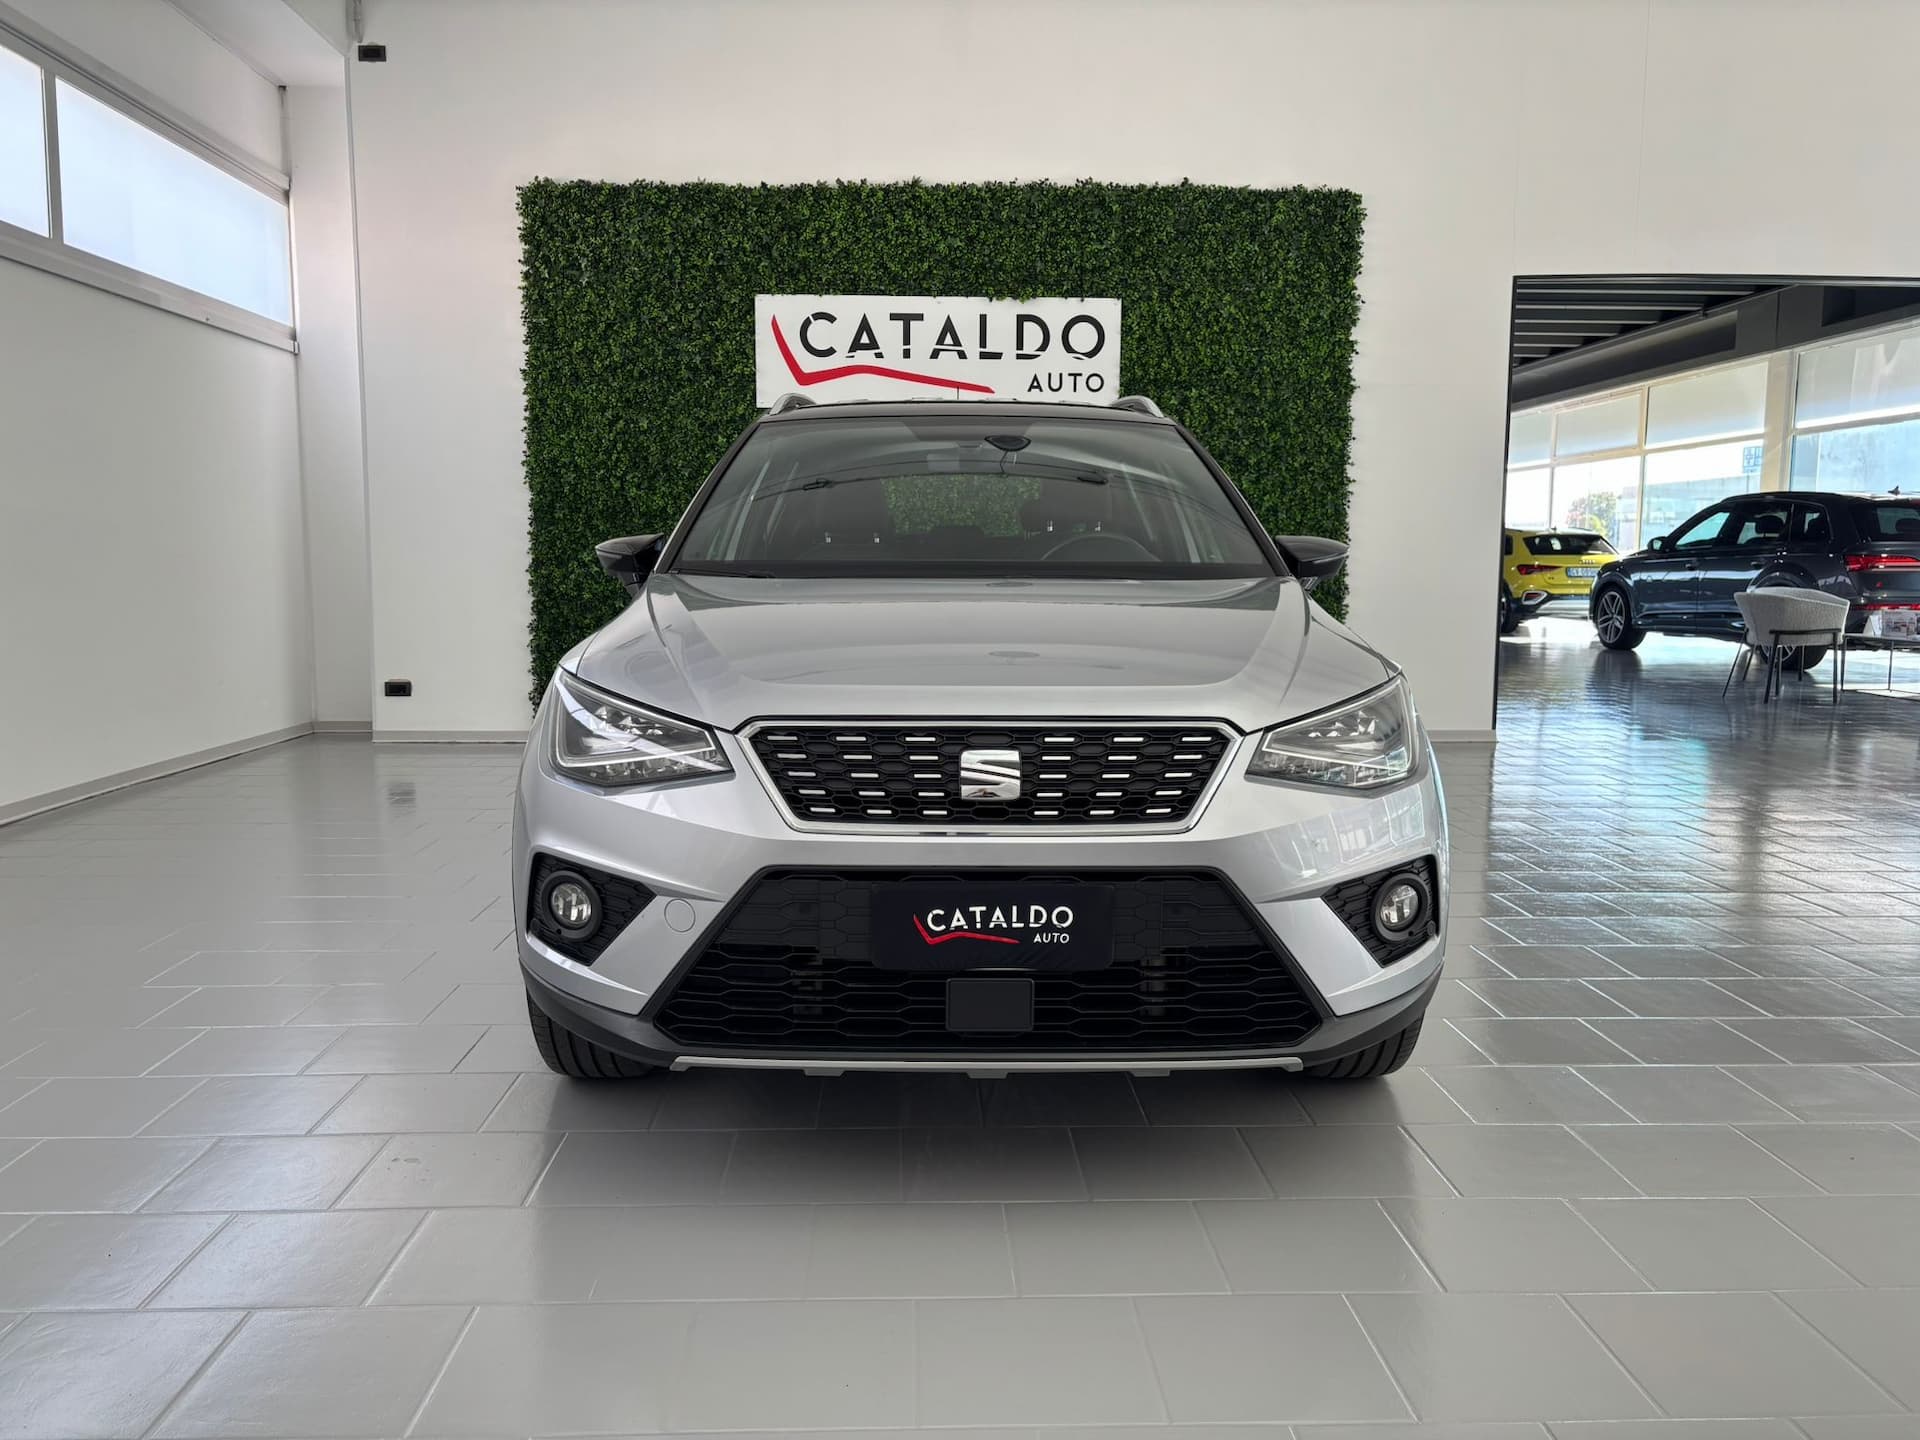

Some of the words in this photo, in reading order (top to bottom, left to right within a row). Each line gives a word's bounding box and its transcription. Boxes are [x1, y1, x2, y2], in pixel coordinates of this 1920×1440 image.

[799, 311, 1106, 360] CATALDO
[1027, 372, 1105, 393] AUTO
[926, 905, 1074, 932] CATALDO
[1033, 932, 1070, 944] AUTO
